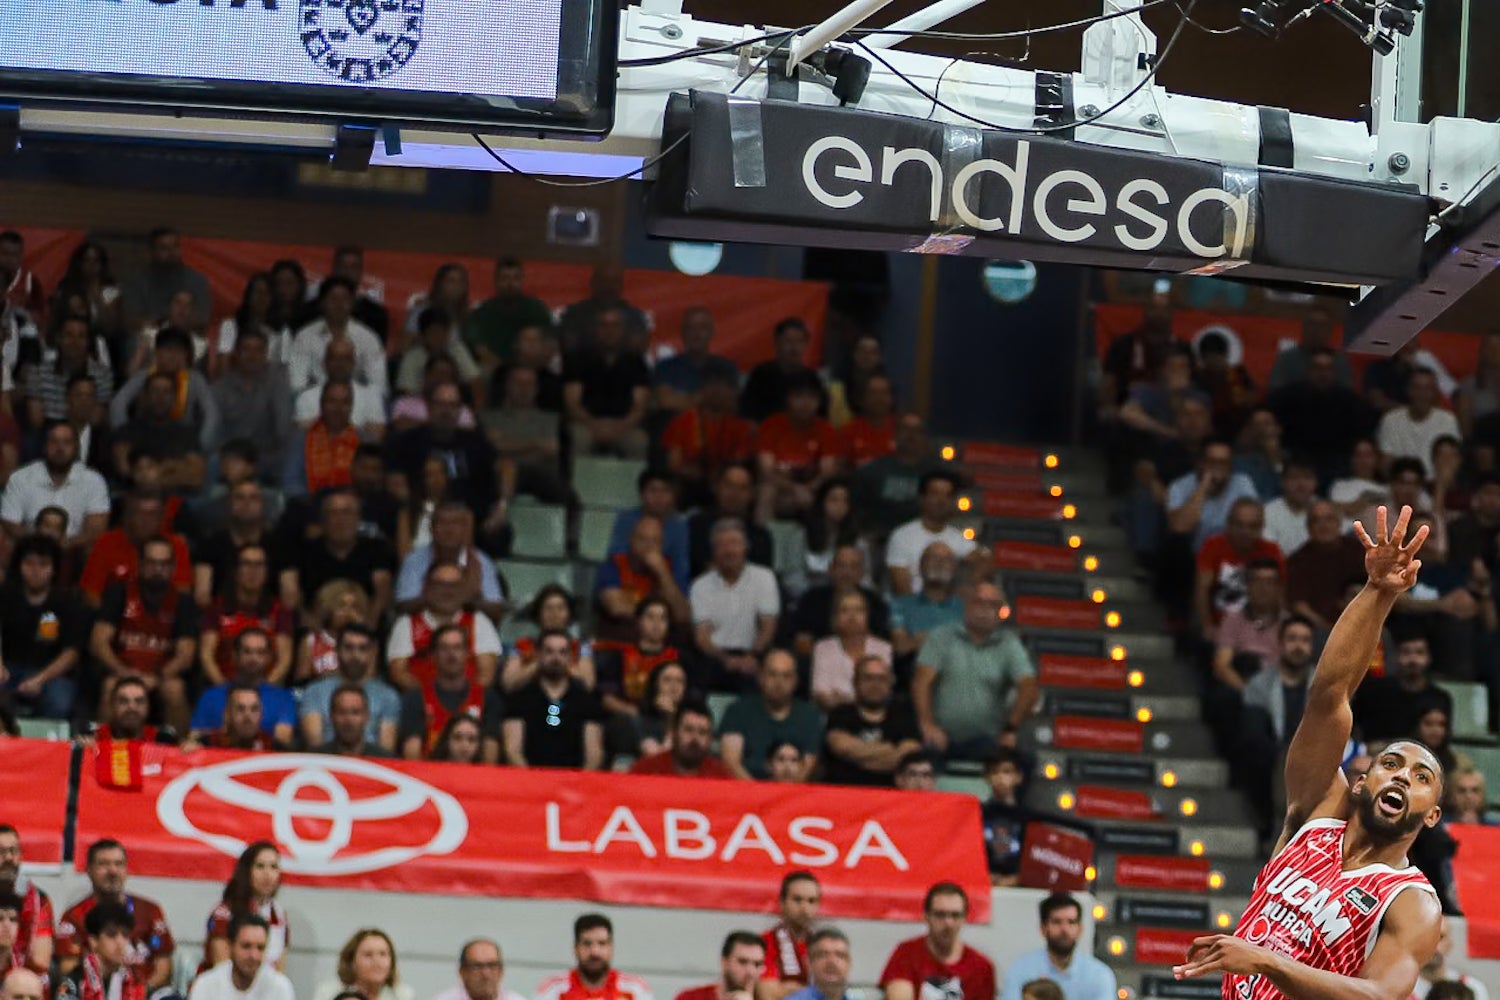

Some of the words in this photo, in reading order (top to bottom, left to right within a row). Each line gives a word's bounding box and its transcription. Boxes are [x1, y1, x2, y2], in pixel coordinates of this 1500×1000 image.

[802, 136, 1250, 258] endesa
[546, 802, 910, 871] LABASA
[1260, 901, 1314, 947] MURCIA
[1266, 866, 1352, 947] UCAM
